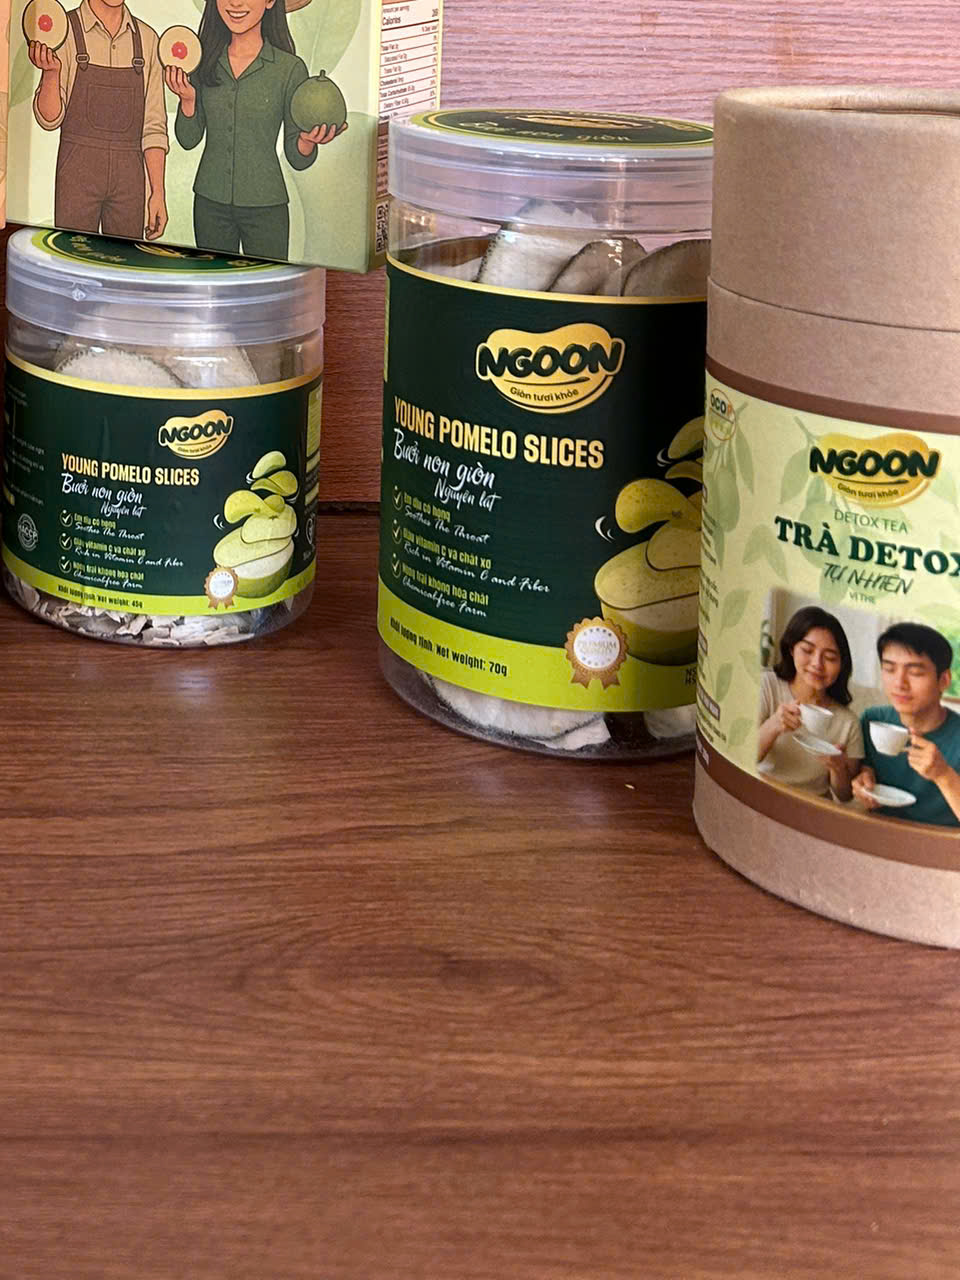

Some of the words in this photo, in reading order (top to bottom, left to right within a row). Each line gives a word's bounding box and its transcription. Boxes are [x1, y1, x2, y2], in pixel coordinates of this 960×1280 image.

[478, 341, 622, 378] NGOON
[510, 386, 532, 399] Giòn
[533, 391, 554, 402] tươi
[555, 387, 579, 401] khỏe
[710, 393, 732, 416] OCOP
[160, 418, 233, 444] NGOON
[394, 395, 435, 440] YOUNG
[439, 415, 517, 459] POMELO
[523, 433, 604, 469] SLICES
[61, 452, 98, 477] YOUNG
[101, 462, 151, 484] POMELO
[154, 467, 200, 486] SLICES
[393, 428, 420, 465] Bưởi
[423, 454, 450, 477] non
[449, 462, 495, 491] giòn
[809, 446, 940, 478] NGOON
[61, 472, 88, 495] Bưởi
[92, 486, 112, 501] non
[111, 487, 143, 508] giòn
[434, 477, 475, 510] Nguyên
[118, 529, 145, 540] Throat
[435, 519, 450, 533] The
[453, 525, 490, 544] Throat
[774, 515, 839, 557] TRÀ
[834, 509, 879, 529] DETOX
[882, 518, 908, 534] TEA
[145, 558, 163, 566] and
[441, 545, 446, 556] C
[436, 557, 475, 578] Vitamin
[480, 569, 489, 580] C
[491, 576, 517, 586] and
[519, 577, 550, 592] Fiber
[824, 562, 848, 583] TỰ
[848, 569, 914, 595] NHIÊN
[458, 600, 487, 617] Farm
[451, 650, 486, 671] weight:
[489, 661, 507, 677] 70g
